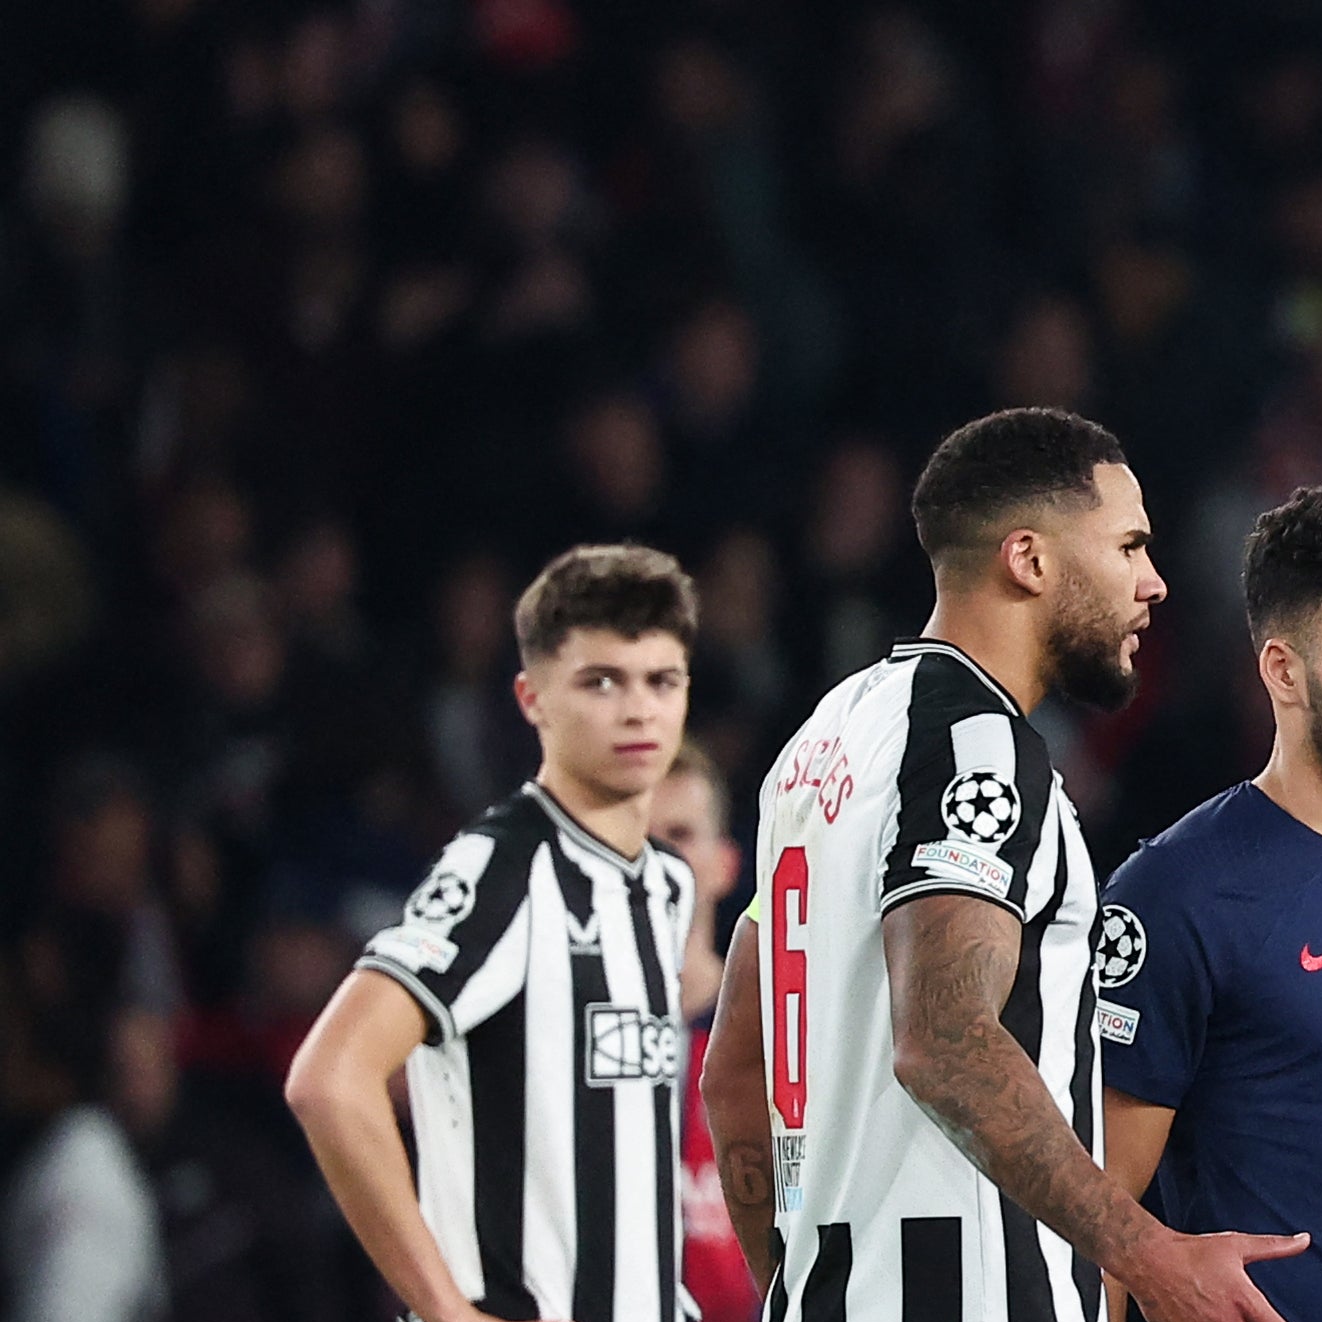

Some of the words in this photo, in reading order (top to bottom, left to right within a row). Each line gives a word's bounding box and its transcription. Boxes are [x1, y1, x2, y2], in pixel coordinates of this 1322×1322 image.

[917, 847, 1009, 886] FOUNDATION
[772, 846, 808, 1129] 6
[1097, 1010, 1134, 1033] TION
